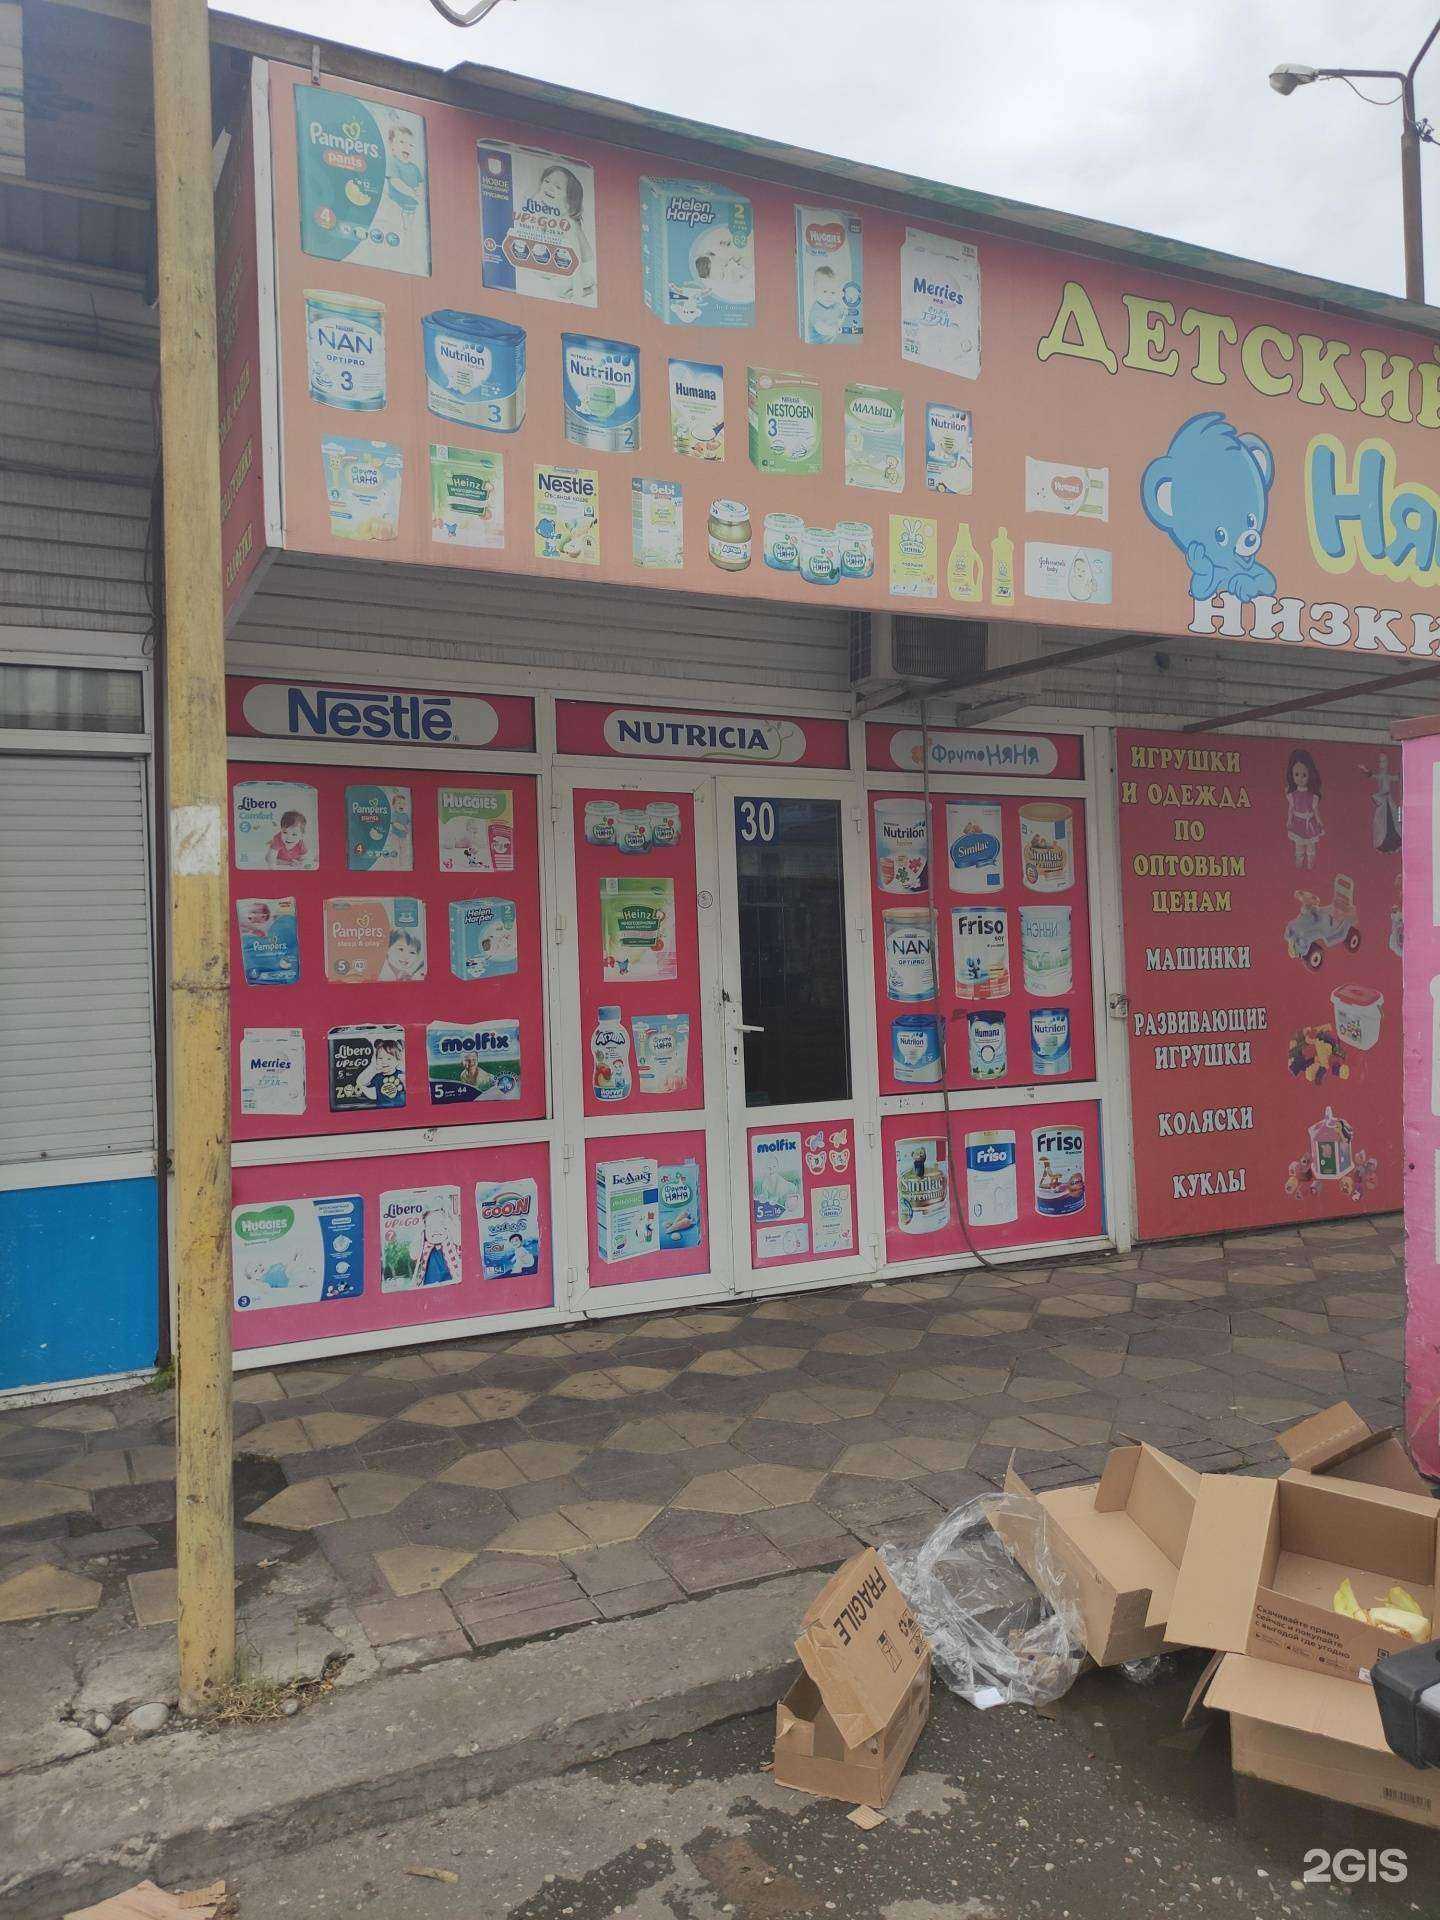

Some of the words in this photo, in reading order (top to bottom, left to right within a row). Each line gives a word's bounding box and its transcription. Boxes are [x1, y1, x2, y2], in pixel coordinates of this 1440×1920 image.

[310, 121, 379, 158] Pampers
[522, 199, 560, 216] Libero
[671, 197, 711, 213] Helen
[735, 204, 745, 218] 2
[667, 207, 715, 227] Harper
[913, 277, 965, 305] Merries
[318, 327, 373, 354] NAN
[326, 354, 365, 366] OPTIPRO
[440, 344, 485, 366] Nutrilon
[570, 359, 632, 384] Nutrilon
[340, 371, 354, 391] 3
[675, 381, 717, 401] Humana
[488, 404, 502, 423] 3
[766, 403, 814, 420] NESTOGEN
[852, 401, 894, 419] МАЛЫШ
[768, 418, 778, 437] 3
[930, 416, 968, 432] Nutrilon
[624, 427, 634, 445] 2
[352, 474, 378, 485] НЯНЯ
[453, 477, 481, 490] Heinz
[538, 472, 594, 496] Nestlé
[1307, 436, 1440, 582] Ня
[288, 687, 453, 742] Nestlé
[617, 719, 769, 751] NUTRICIA
[1130, 746, 1241, 773] ИГРУШКИ
[238, 796, 277, 811] Libero
[1121, 782, 1138, 804] И
[1147, 782, 1251, 809] ОДЕЖДА
[352, 801, 388, 816] Pampers
[740, 800, 775, 842] 30
[1174, 819, 1205, 841] ПО
[883, 824, 925, 840] Nutrilon
[958, 840, 989, 858] Similac
[1133, 854, 1246, 877] ОПТОВЫМ
[1152, 890, 1232, 914] ЦЕНАМ
[624, 909, 657, 920] Heinz
[332, 922, 385, 940] Pampers
[958, 915, 1004, 936] Friso
[253, 940, 288, 953] Pampers
[892, 939, 931, 955] NAN
[1145, 945, 1251, 972] МАШИНКИ
[1034, 1023, 1066, 1034] Nutrilon
[1134, 1007, 1267, 1037] РАЗВИВАЮЩИЕ
[974, 1027, 1000, 1037] Humana
[441, 1031, 509, 1052] molfix
[900, 1037, 924, 1046] Nutrilon
[335, 1044, 372, 1059] Libero
[1154, 1041, 1251, 1070] ИГРУШКИ
[251, 1057, 291, 1071] Merries
[434, 1084, 444, 1098] 5
[1158, 1105, 1254, 1137] КОЛЯСКИ
[757, 1138, 797, 1154] molfix
[1037, 1131, 1083, 1153] Friso
[976, 1150, 1007, 1164] Friso
[1172, 1168, 1246, 1199] КУКЛЫ
[665, 1191, 688, 1202] НЯНЯ
[383, 1203, 423, 1219] Libero
[833, 1566, 888, 1647] FRAGILE
[1310, 1625, 1340, 1640] прямо
